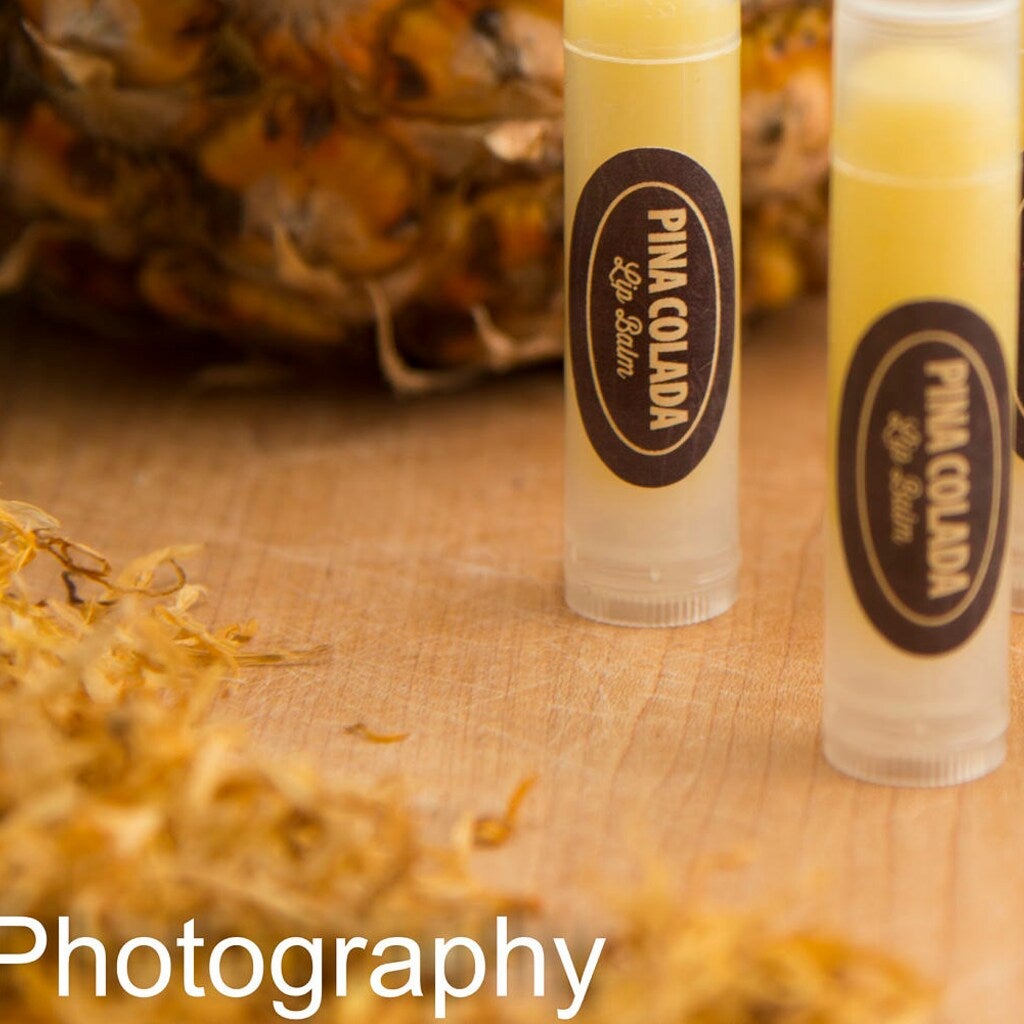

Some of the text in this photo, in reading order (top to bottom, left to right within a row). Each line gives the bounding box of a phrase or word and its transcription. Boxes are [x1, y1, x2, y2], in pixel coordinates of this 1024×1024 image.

[609, 255, 643, 380] Lip Balm
[647, 207, 689, 431] PINA COLADA
[923, 358, 971, 600] PINA COLADA
